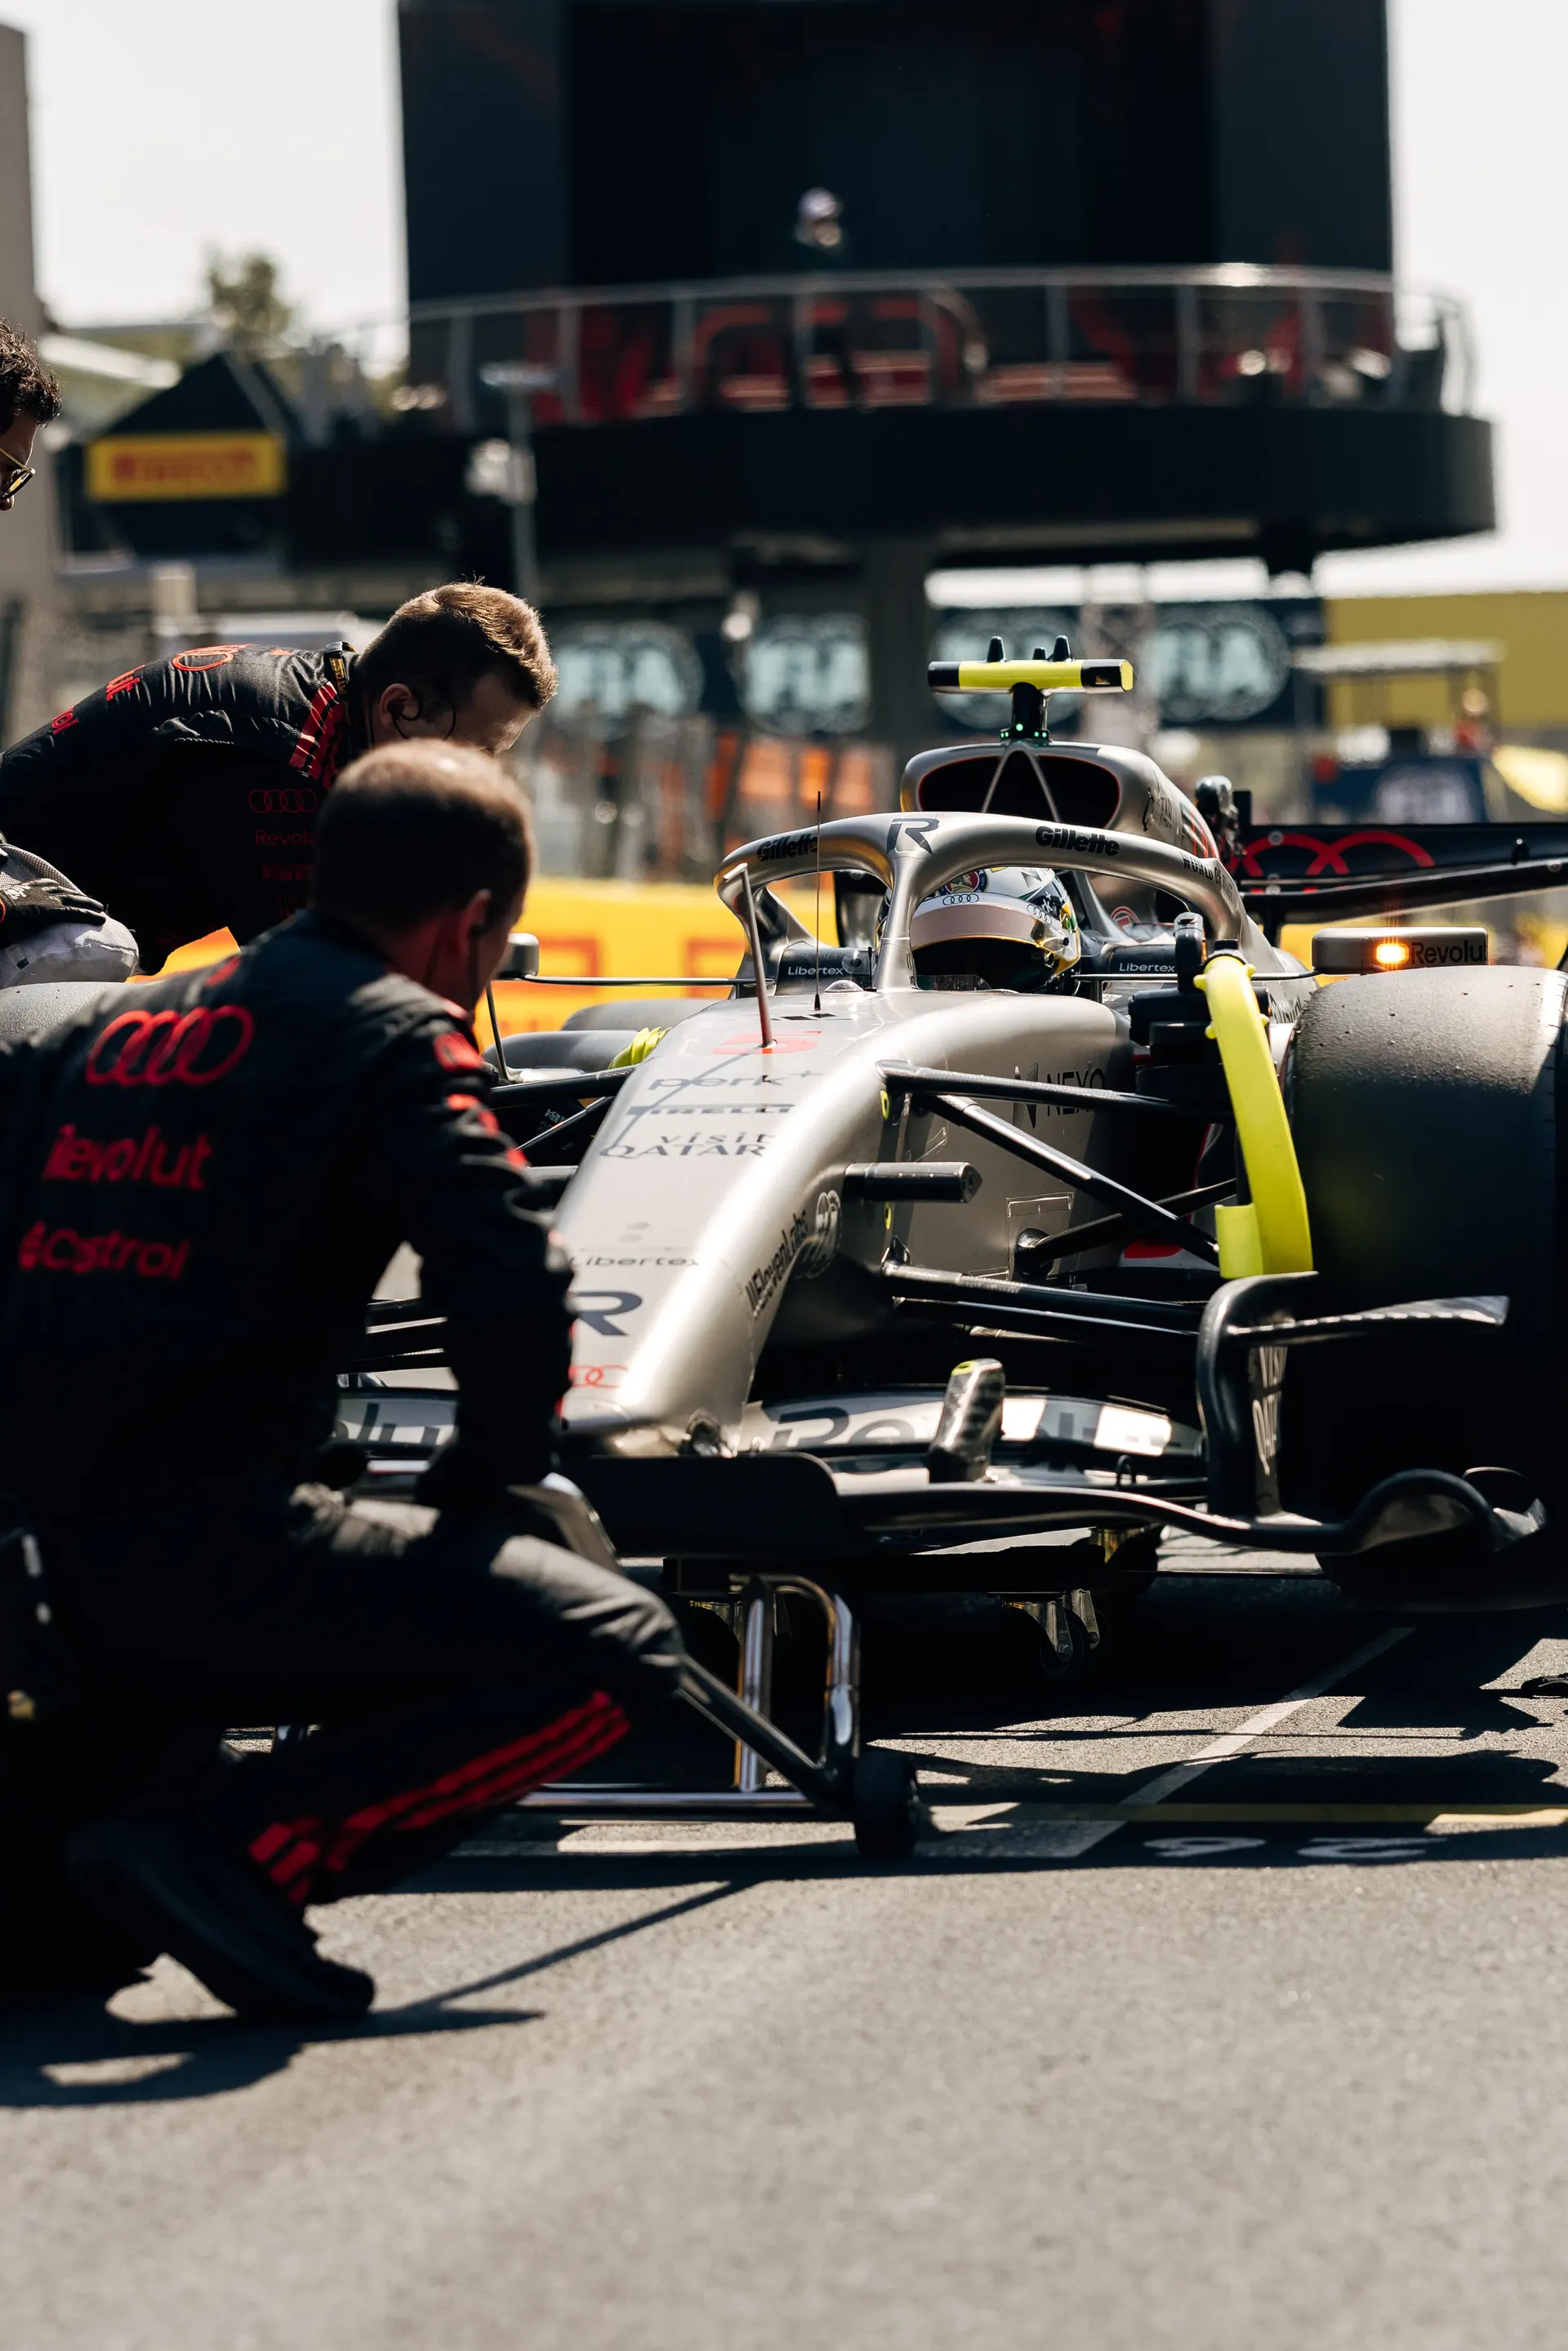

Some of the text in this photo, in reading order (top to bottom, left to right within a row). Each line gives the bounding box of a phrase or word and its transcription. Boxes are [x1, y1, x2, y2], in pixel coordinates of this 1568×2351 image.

[1036, 825, 1120, 856] Gillette
[756, 833, 818, 862] Gillette
[788, 966, 843, 975] Libertex
[1119, 963, 1175, 973] Libertex
[626, 1104, 795, 1116] PIRELLI
[660, 1131, 776, 1144] visit
[599, 1143, 766, 1160] QATAR
